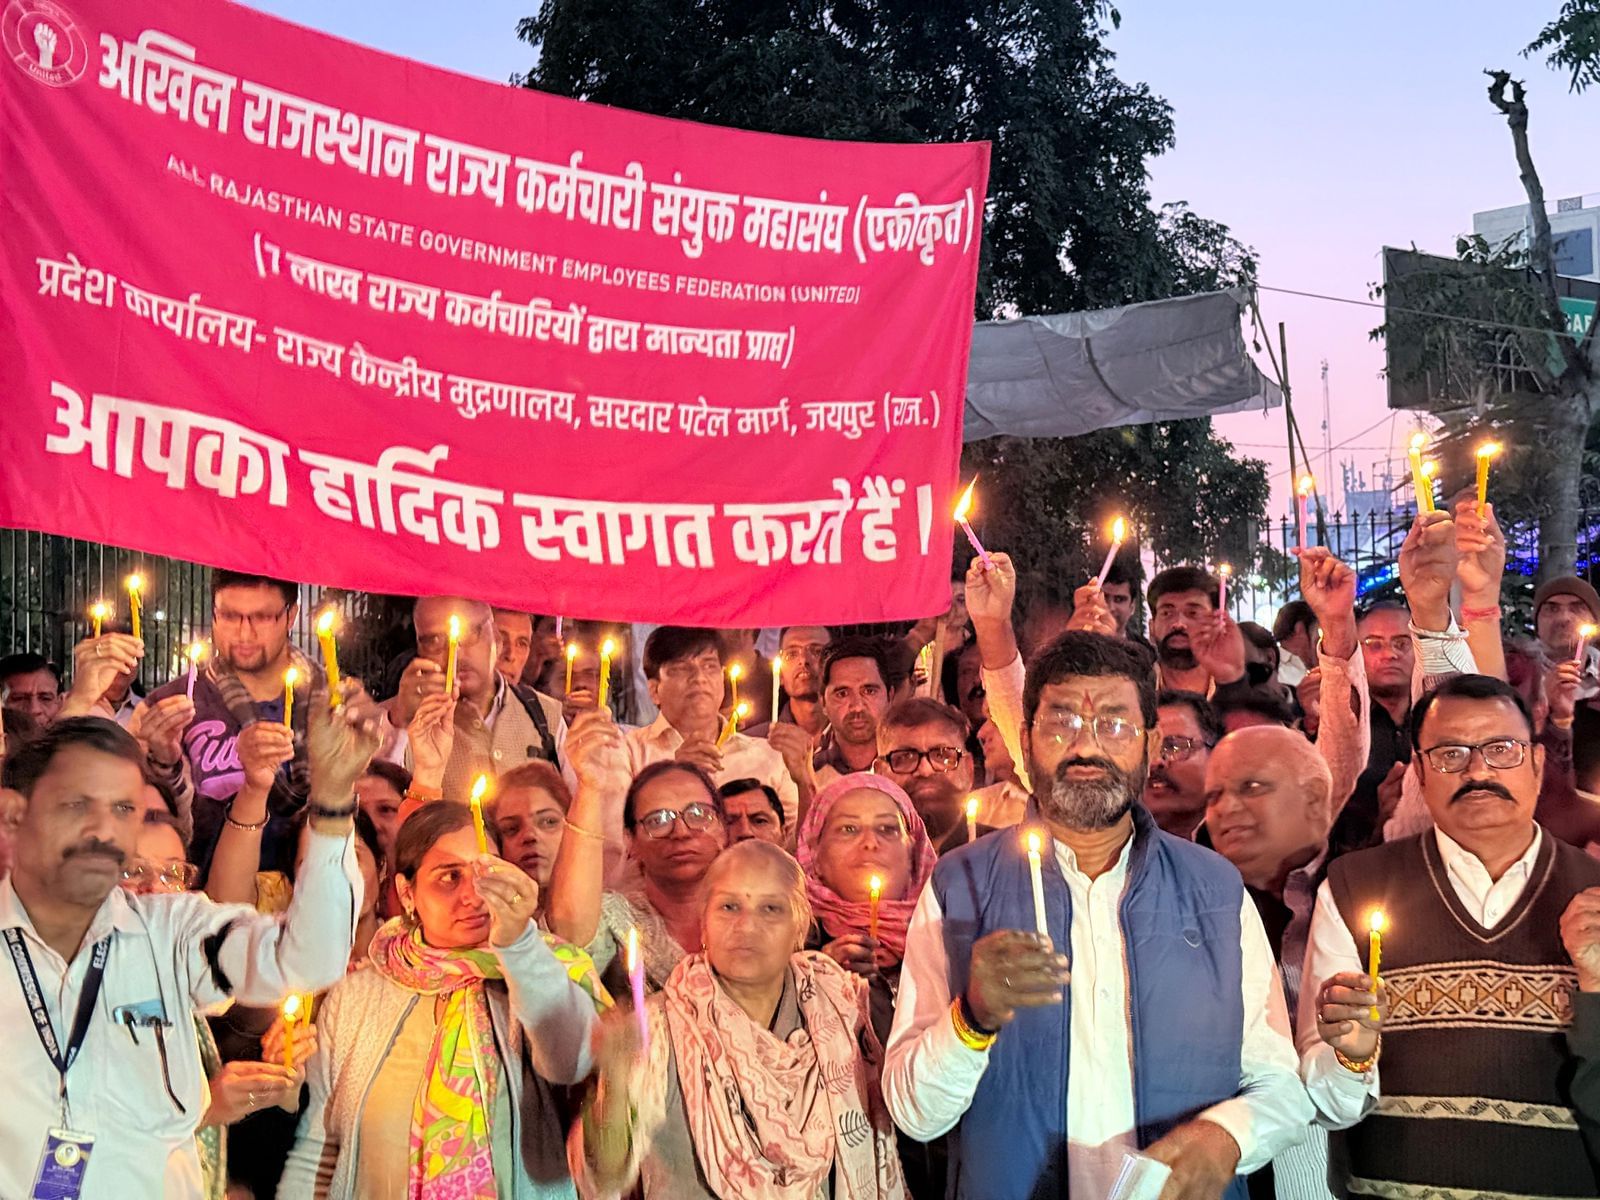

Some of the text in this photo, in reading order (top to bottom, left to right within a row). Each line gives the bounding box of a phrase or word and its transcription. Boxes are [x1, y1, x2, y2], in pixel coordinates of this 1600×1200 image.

[98, 29, 975, 267] अखिल राजस्थान राज्य कर्मचारी संयुक्त महासंघ (एकीकृत)
[167, 155, 861, 304] ALL RAJASTHAN STATE GOVERNMENT EMPLOYEES FEDERATION (UNITED)
[36, 252, 117, 308] प्रदेश
[273, 326, 346, 378] राज्य
[348, 341, 443, 403] केन्द्रीय
[446, 374, 581, 430] मुद्रणालय,
[586, 395, 675, 434] सरदार
[677, 396, 732, 437] पटेल
[734, 397, 798, 437] मार्ग,
[801, 400, 876, 440] जयपुर
[883, 390, 940, 433] (राज.)
[285, 252, 363, 305] लाख
[366, 274, 441, 321] राज्य
[444, 290, 587, 345] कर्मचारियों
[586, 315, 642, 354] द्वारा
[643, 323, 743, 360] मान्यता
[745, 325, 796, 370] प्राप्त)
[46, 381, 291, 507] आपका
[298, 444, 505, 553] हार्दिक
[512, 492, 716, 569] स्वागत
[723, 477, 855, 567] करते
